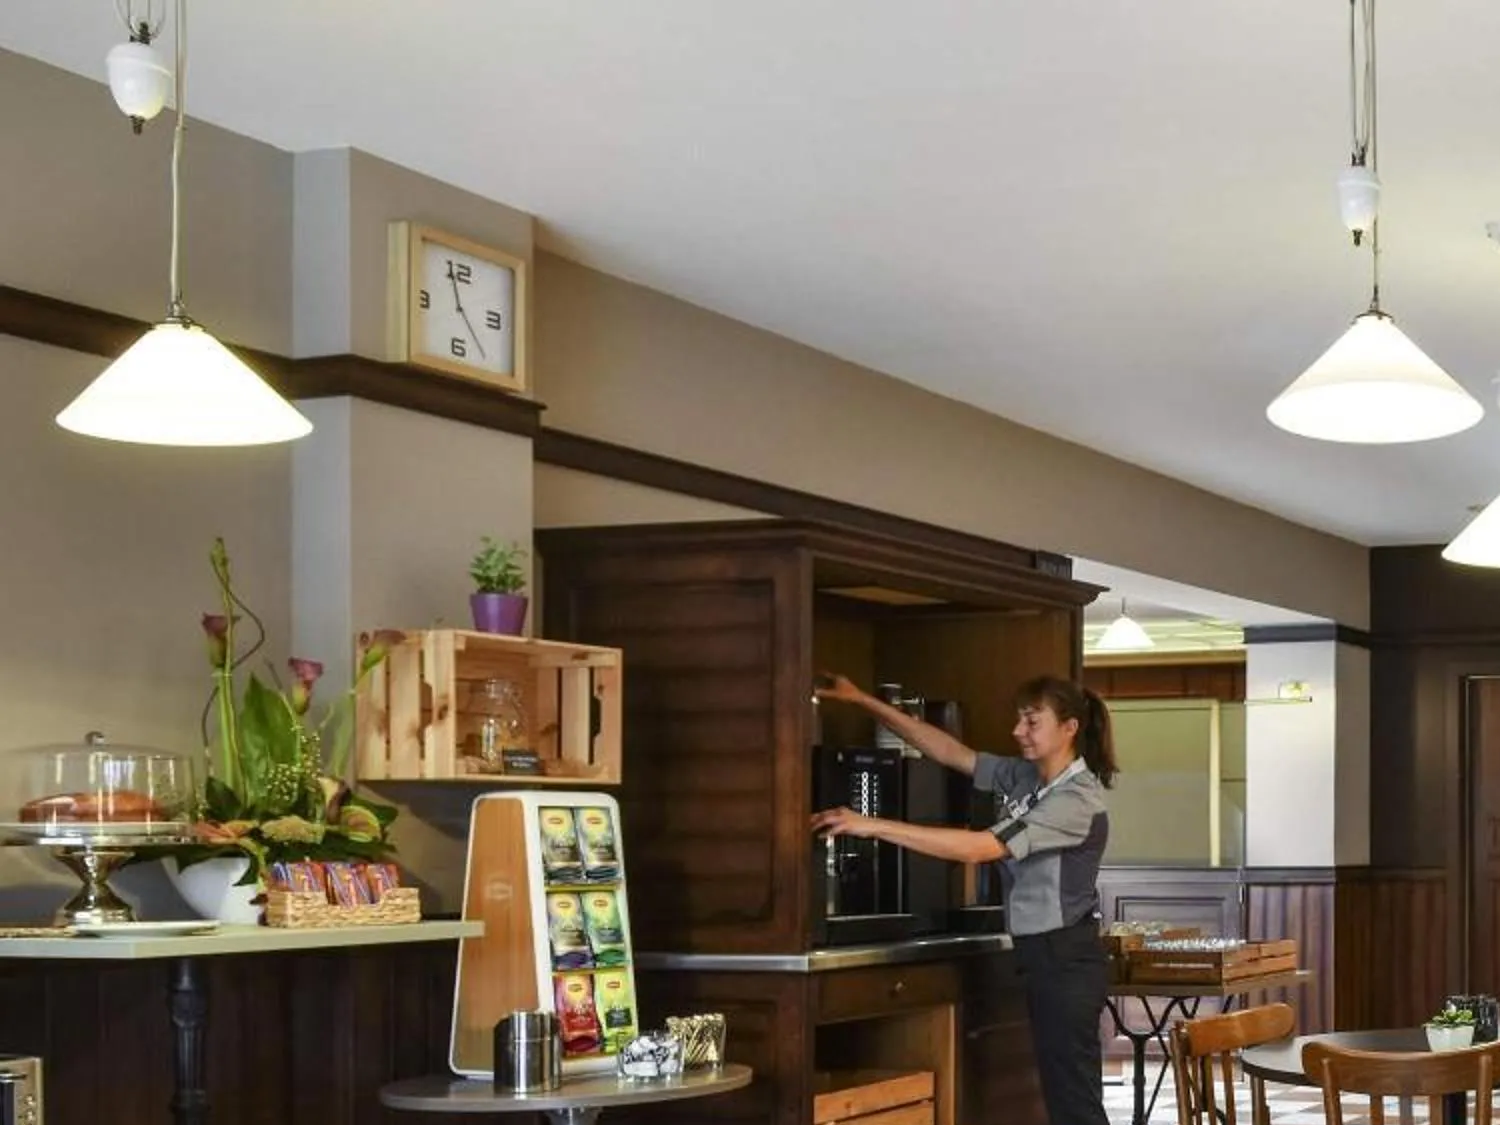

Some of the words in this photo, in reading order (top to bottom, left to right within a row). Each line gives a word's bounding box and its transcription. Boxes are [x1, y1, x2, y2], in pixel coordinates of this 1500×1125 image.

[445, 260, 472, 285] 12
[485, 311, 502, 331] 3
[451, 337, 467, 358] 6
